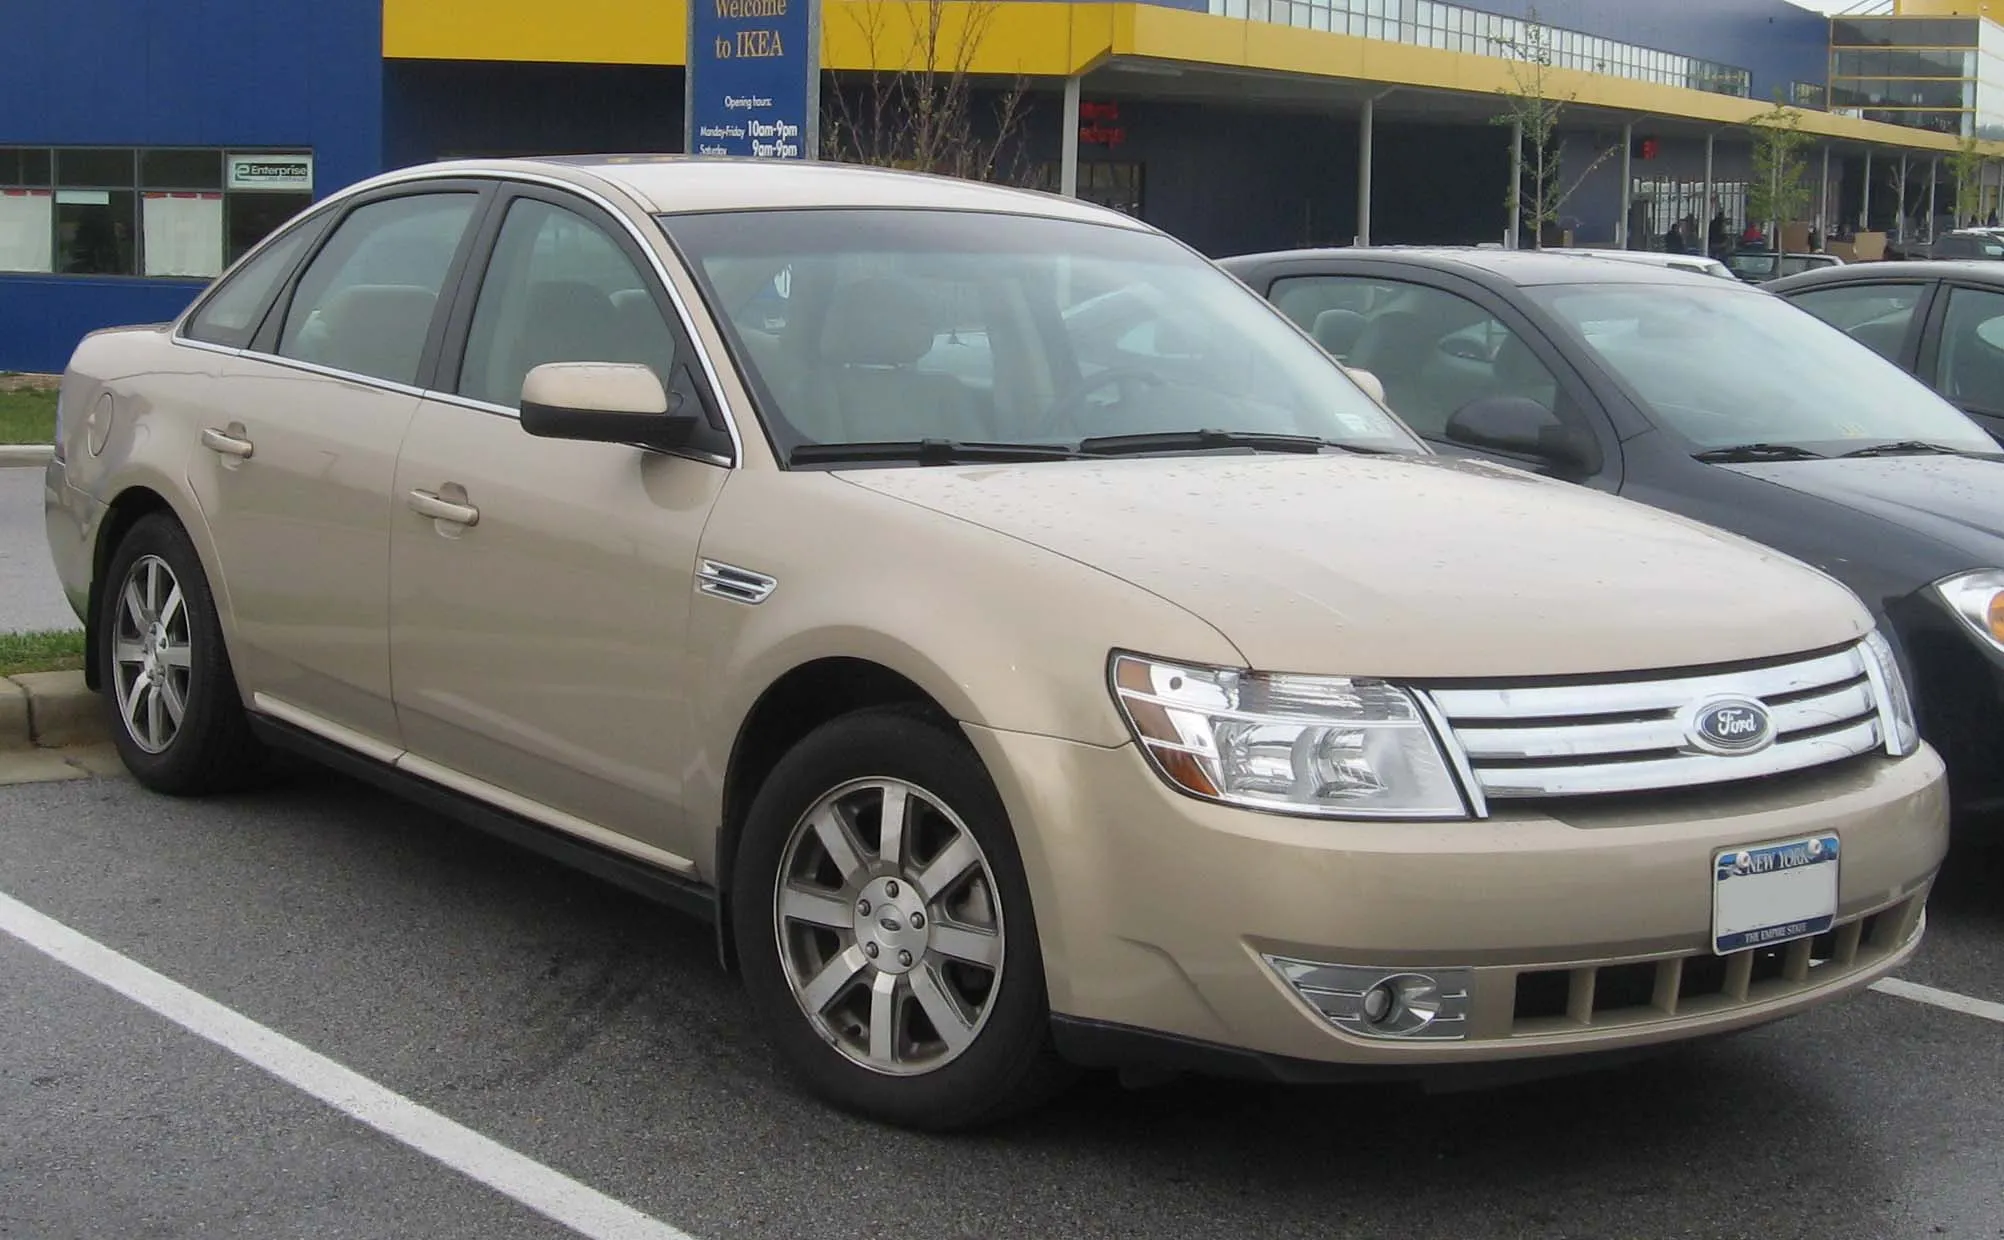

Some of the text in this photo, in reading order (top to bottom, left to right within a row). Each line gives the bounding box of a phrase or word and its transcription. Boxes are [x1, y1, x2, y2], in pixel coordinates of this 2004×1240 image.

[715, 0, 787, 18] Welcome
[715, 30, 784, 58] to IKEA
[724, 95, 752, 110] Opening
[700, 120, 798, 141] Monday-Friday 10am-9pm
[700, 139, 798, 158] Saturday 9am-9pm
[251, 165, 307, 177] Enterprise
[1717, 709, 1757, 735] Ford
[1747, 847, 1809, 874] NEW YORK
